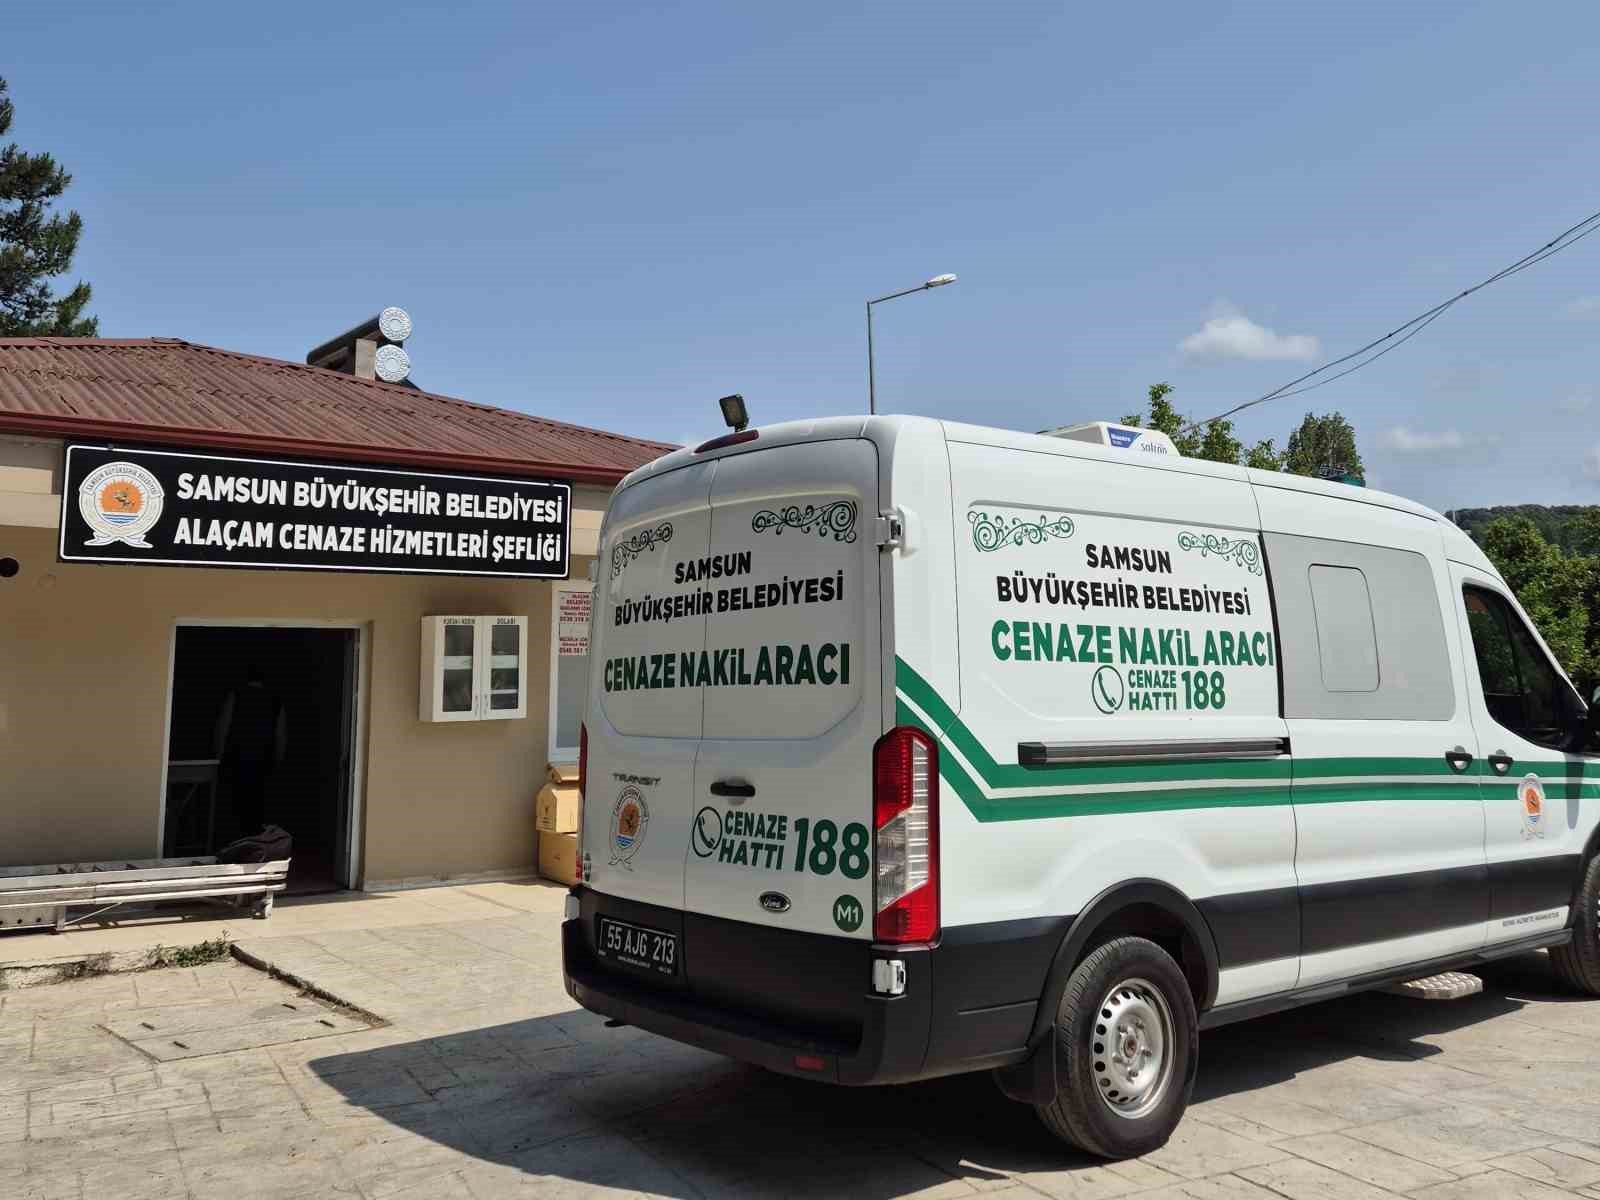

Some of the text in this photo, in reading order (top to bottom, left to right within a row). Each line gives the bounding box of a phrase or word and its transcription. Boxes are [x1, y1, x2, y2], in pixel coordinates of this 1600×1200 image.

[177, 472, 288, 507] SAMSUN
[294, 475, 441, 519] BÜYÜKŞEHİR
[446, 492, 562, 523] BELEDİYESİ
[173, 516, 562, 563] ALAÇAM CENAZE HİZMETLERİ ŞEFLİĞİ
[1086, 543, 1172, 574] SAMSUN
[674, 551, 752, 585] SAMSUN
[614, 570, 844, 627] BÜYÜKŞEHİR BELEDİYESİ
[996, 570, 1251, 616] BÜYÜKŞEHİR BELEDİYESİ
[991, 619, 1114, 665] CENAZE
[1203, 630, 1275, 666] ARACI
[604, 653, 676, 693] CENAZE
[753, 643, 850, 686] ARACI
[1127, 669, 1177, 689] CENAZE
[1128, 692, 1178, 711] HATTI
[1181, 670, 1226, 710] 188
[612, 772, 662, 787] TRANSIT
[725, 810, 788, 841] CENAZE
[718, 838, 784, 871] HATTI
[794, 817, 870, 880] 188
[837, 904, 860, 923] M1
[607, 925, 622, 950] 55
[624, 930, 648, 957] AJG
[652, 936, 675, 964] 213
